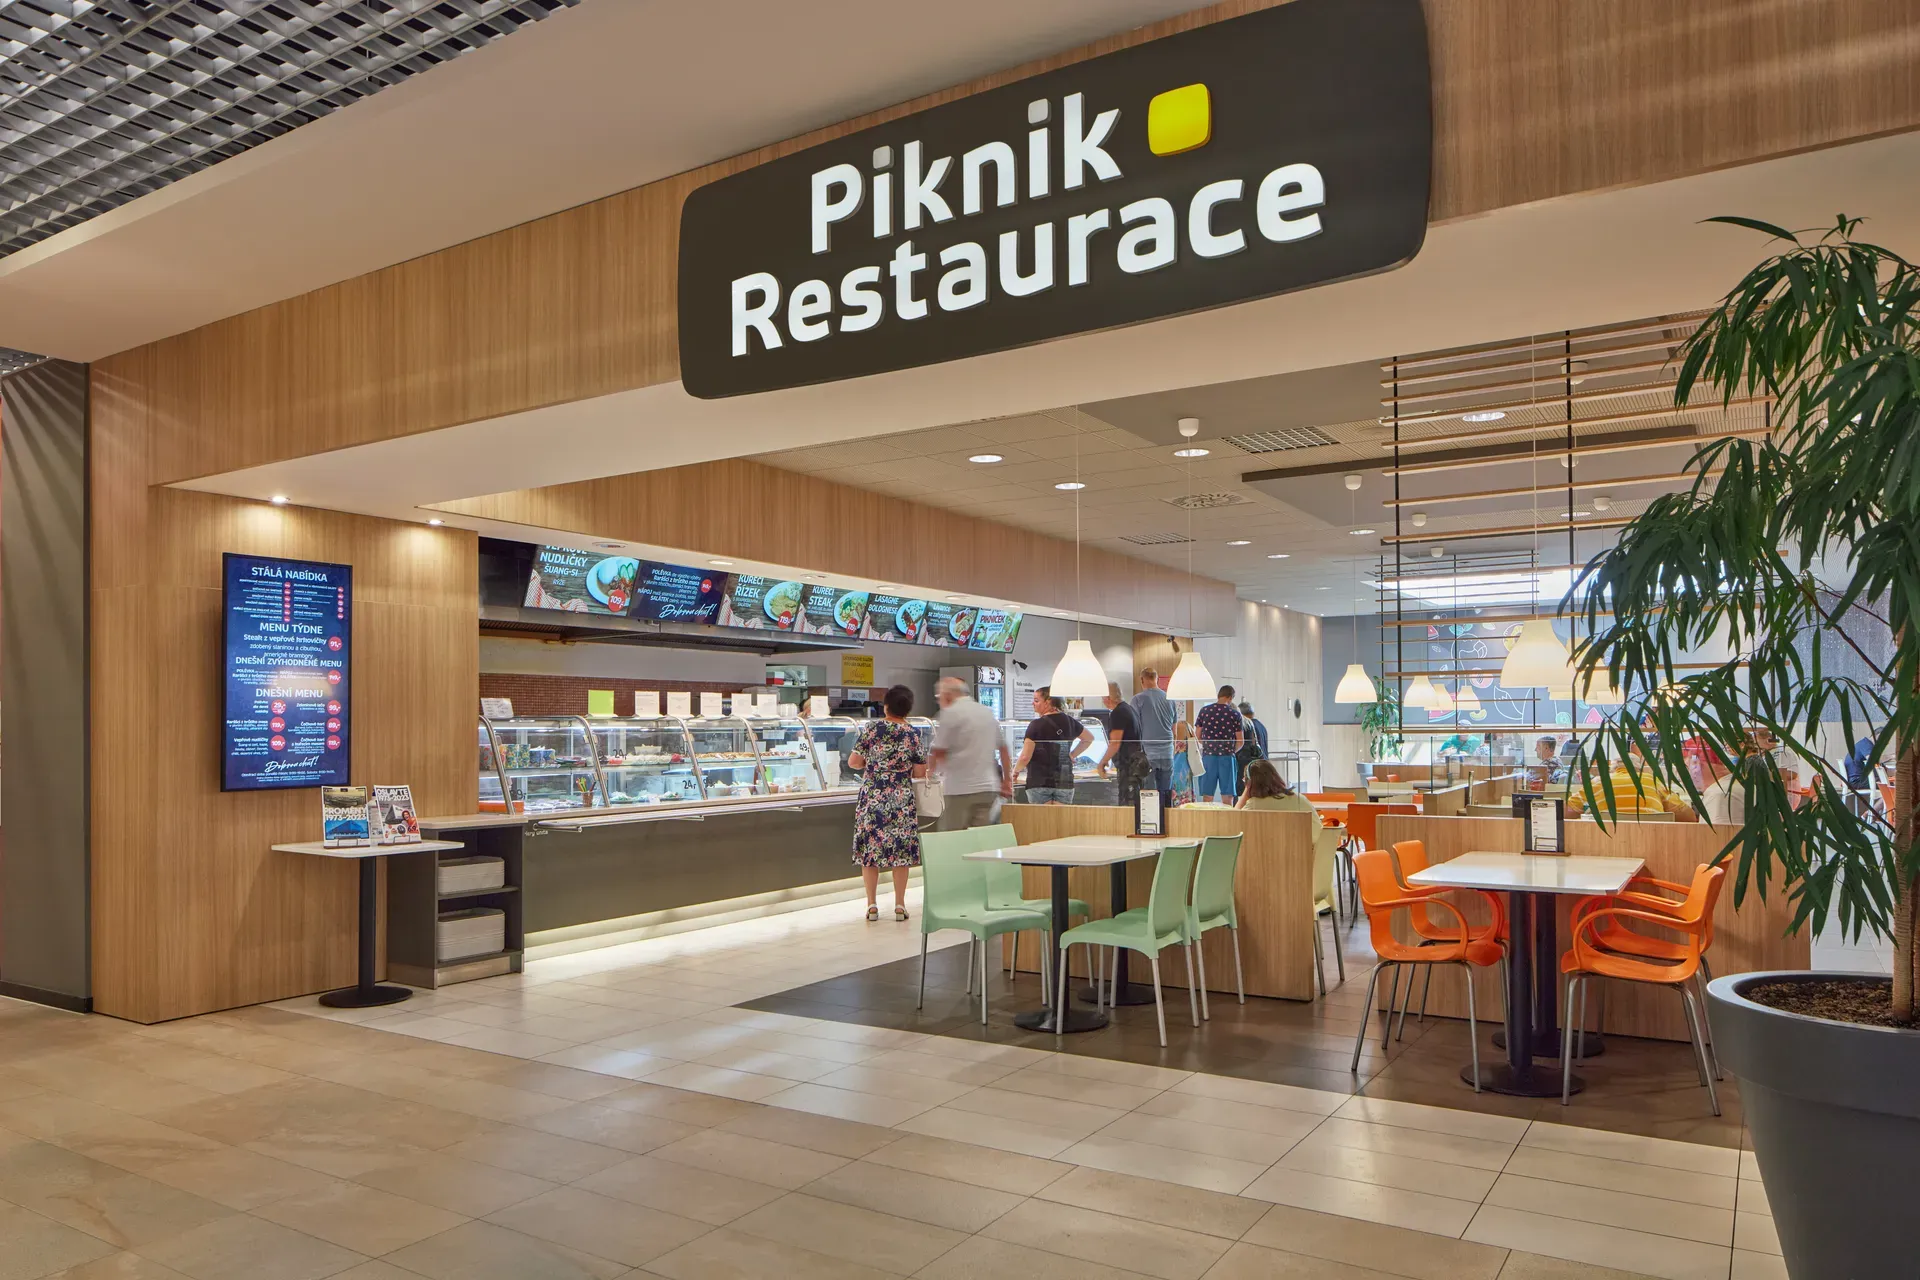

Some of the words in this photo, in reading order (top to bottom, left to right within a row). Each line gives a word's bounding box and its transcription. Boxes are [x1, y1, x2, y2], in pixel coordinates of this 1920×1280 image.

[812, 92, 1122, 254] Piknik
[731, 163, 1325, 357] Restaurace
[540, 552, 588, 567] NUDLIČKY
[252, 566, 282, 578] STÁLÁ
[285, 570, 327, 582] NABÍDKA
[544, 563, 578, 577] ŠUANG-SI
[637, 587, 653, 595] NÁPOJ
[735, 583, 760, 598] ŘÍZEK
[808, 596, 833, 607] STEAK
[875, 595, 900, 604] LASAGNE
[260, 623, 289, 632] MENU
[291, 623, 323, 634] TÝDNE
[269, 635, 295, 643] vepřové
[250, 643, 272, 651] zdobený
[236, 655, 265, 665] DNEŠNÍ
[267, 656, 318, 667] ZVÝHODNĚNÉ
[320, 659, 342, 667] MENU
[255, 686, 292, 698] DNEŠNÍ
[295, 689, 323, 698] MENU
